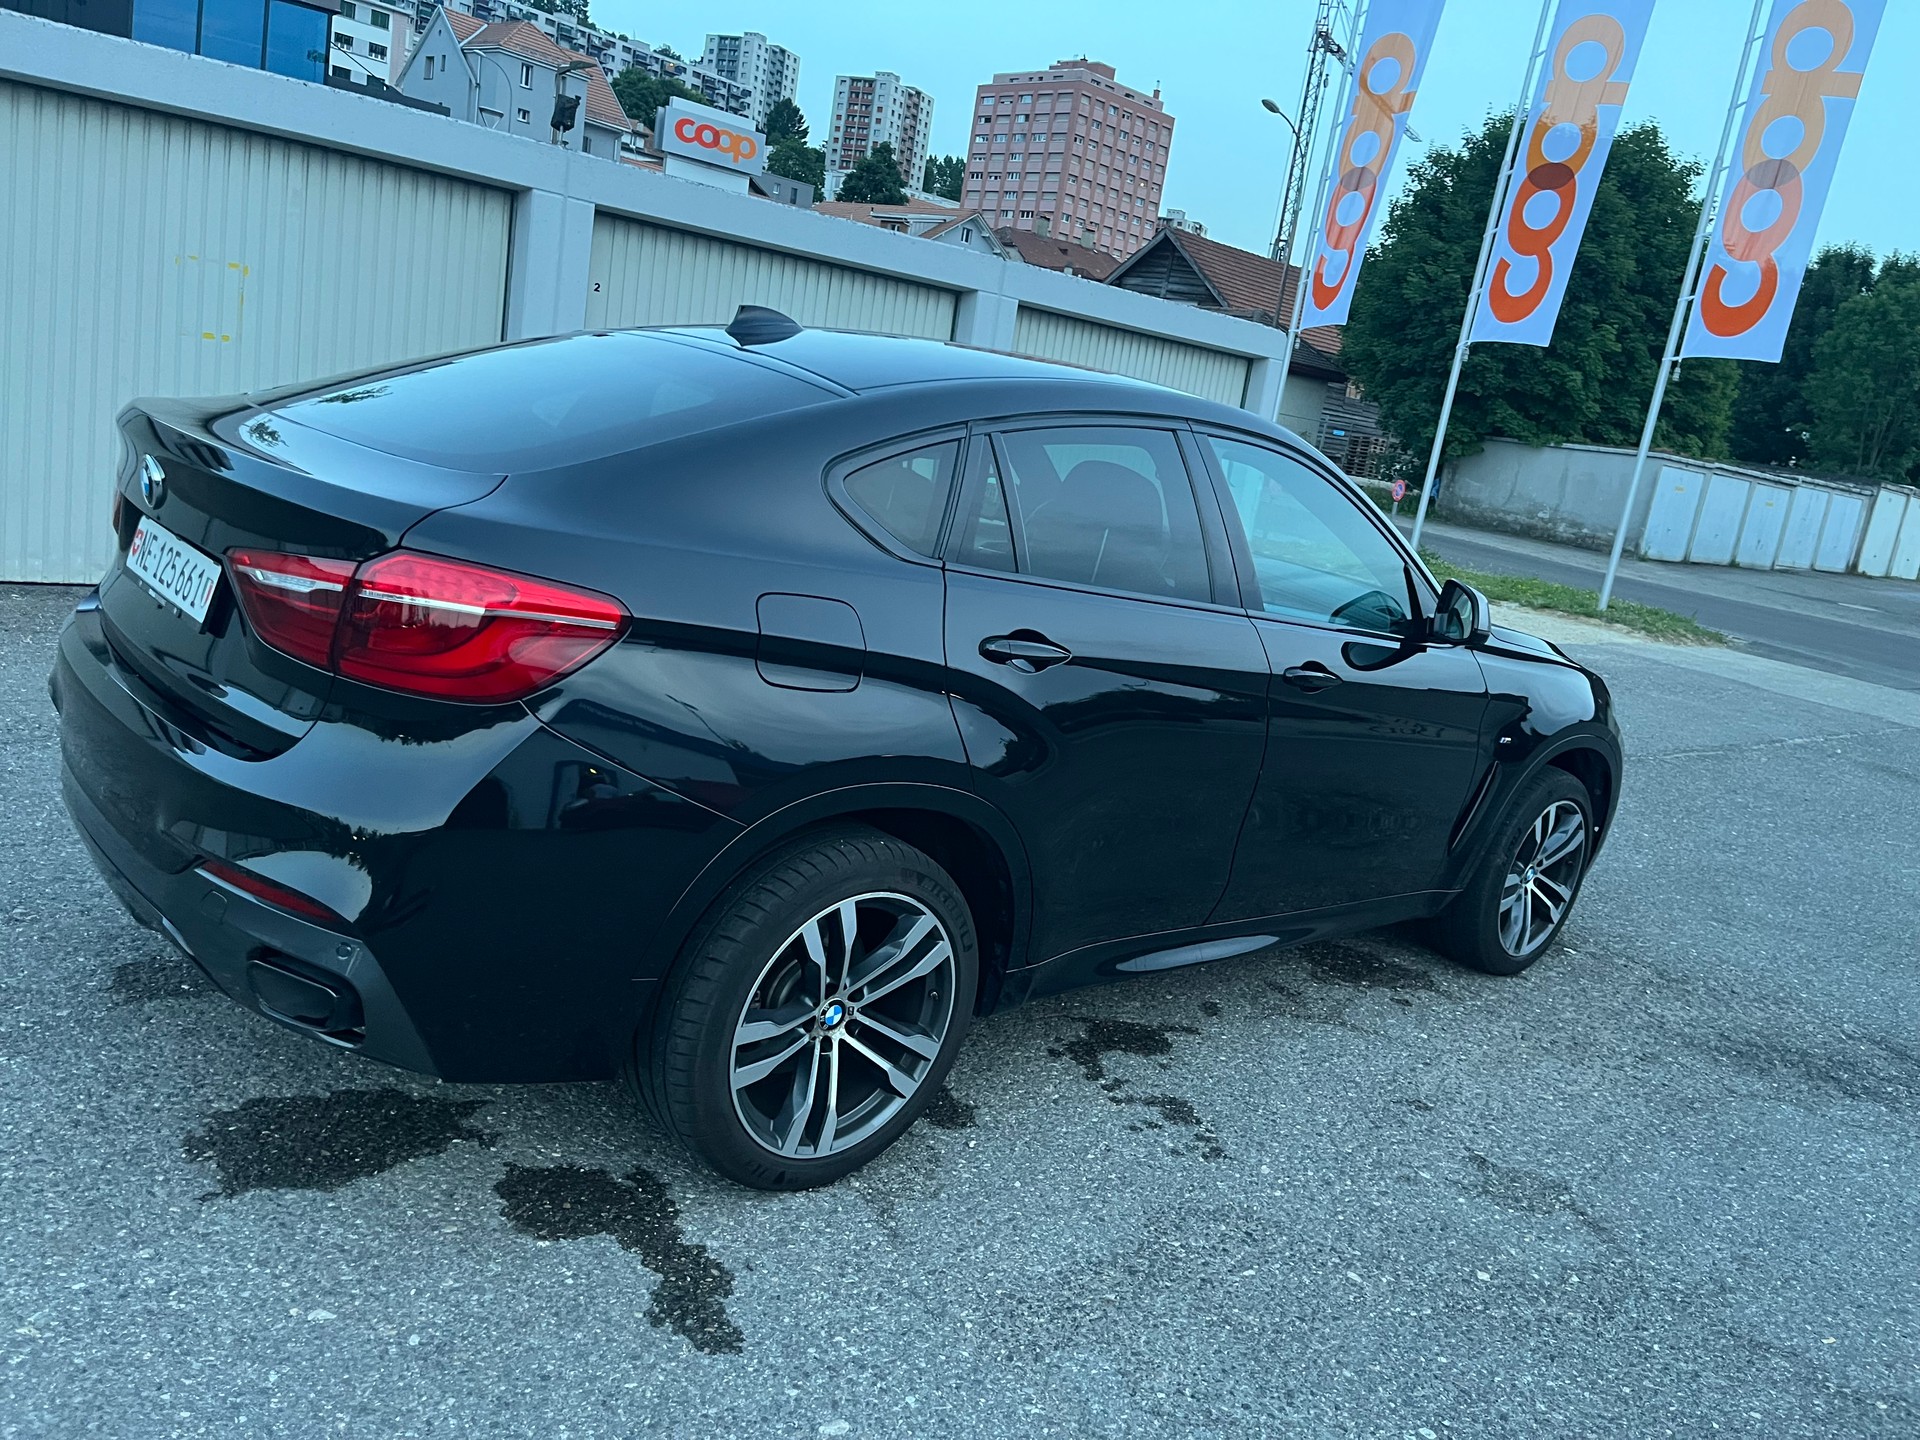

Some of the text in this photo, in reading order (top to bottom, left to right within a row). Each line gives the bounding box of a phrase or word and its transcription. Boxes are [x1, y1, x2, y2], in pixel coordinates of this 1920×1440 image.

[674, 118, 757, 164] coop
[1312, 32, 1416, 310] coop
[1489, 13, 1629, 323] coop
[1701, 0, 1863, 337] coop
[593, 282, 601, 293] 2
